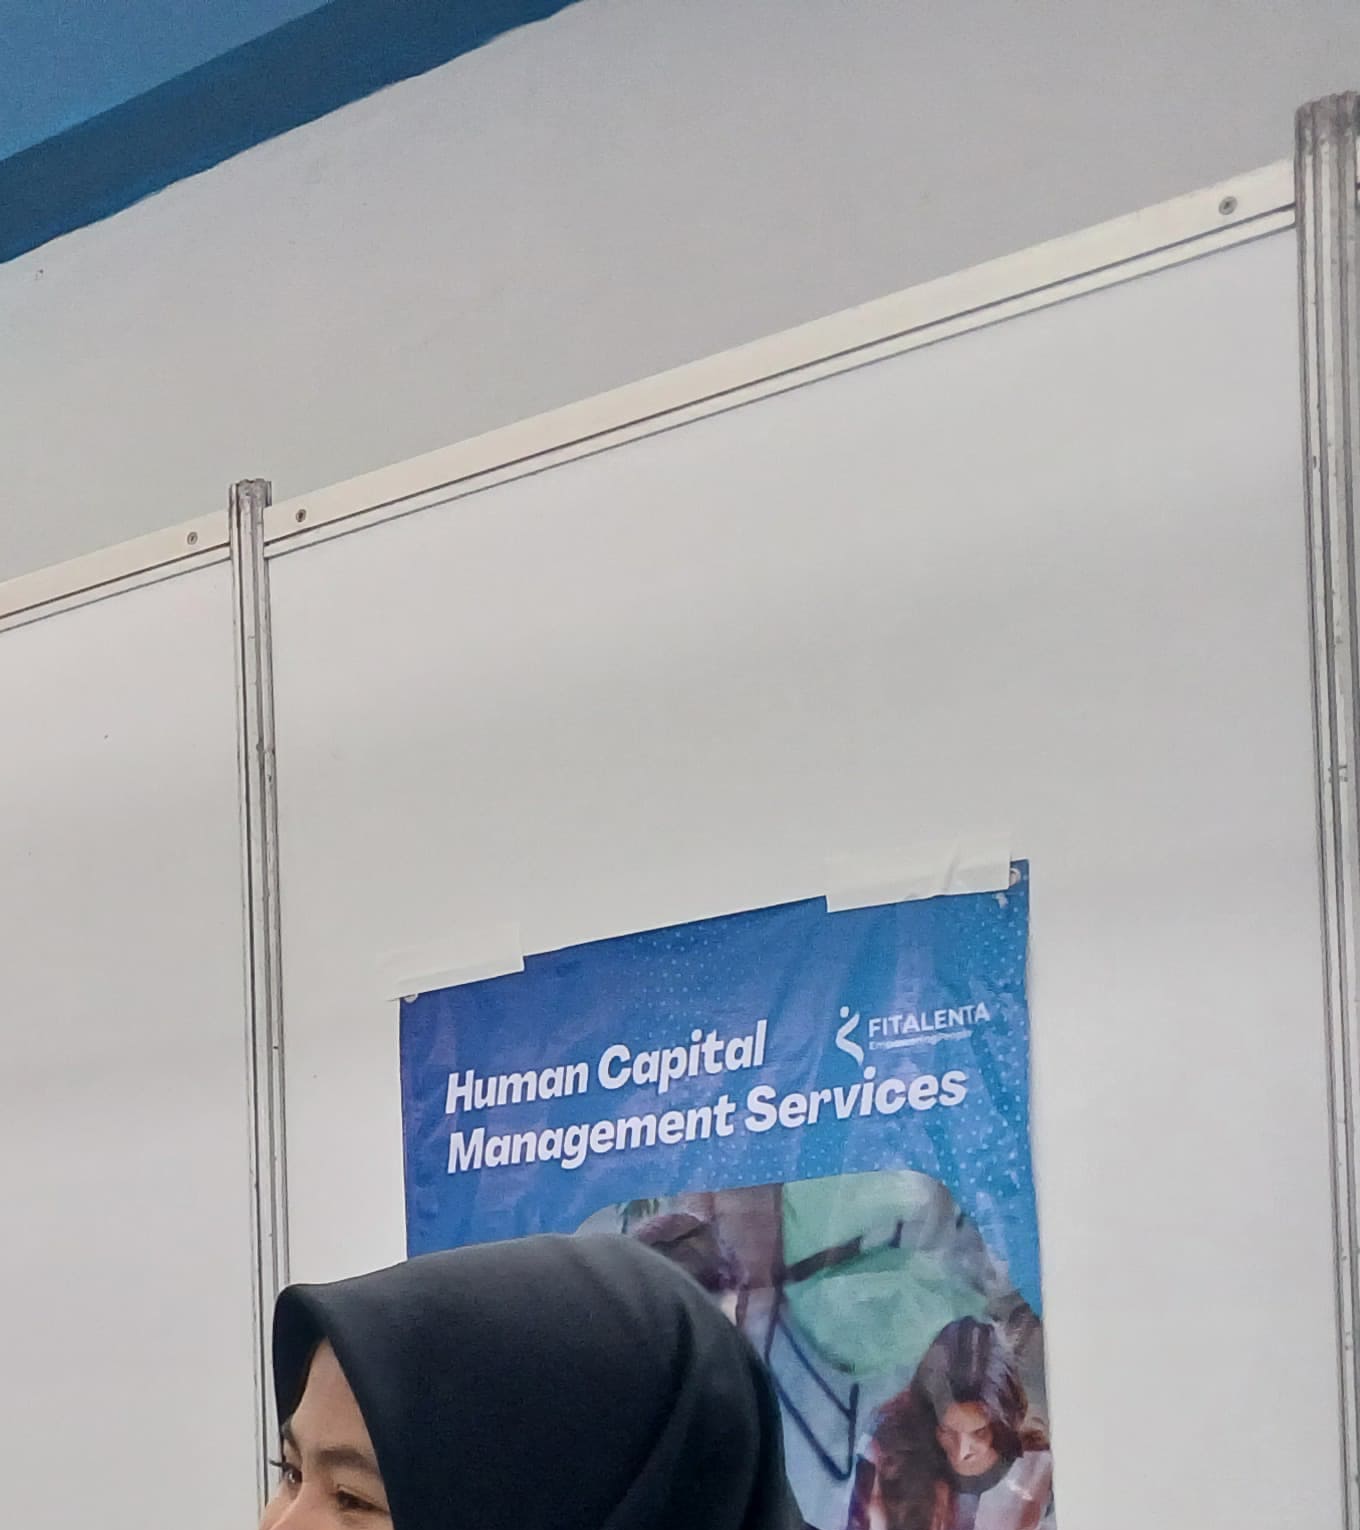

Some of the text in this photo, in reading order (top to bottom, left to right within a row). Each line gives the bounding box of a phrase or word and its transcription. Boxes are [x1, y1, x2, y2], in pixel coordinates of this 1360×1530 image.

[445, 1019, 767, 1115] Human Capital
[868, 1001, 991, 1037] FITALENTA
[447, 1066, 969, 1174] Management Services
